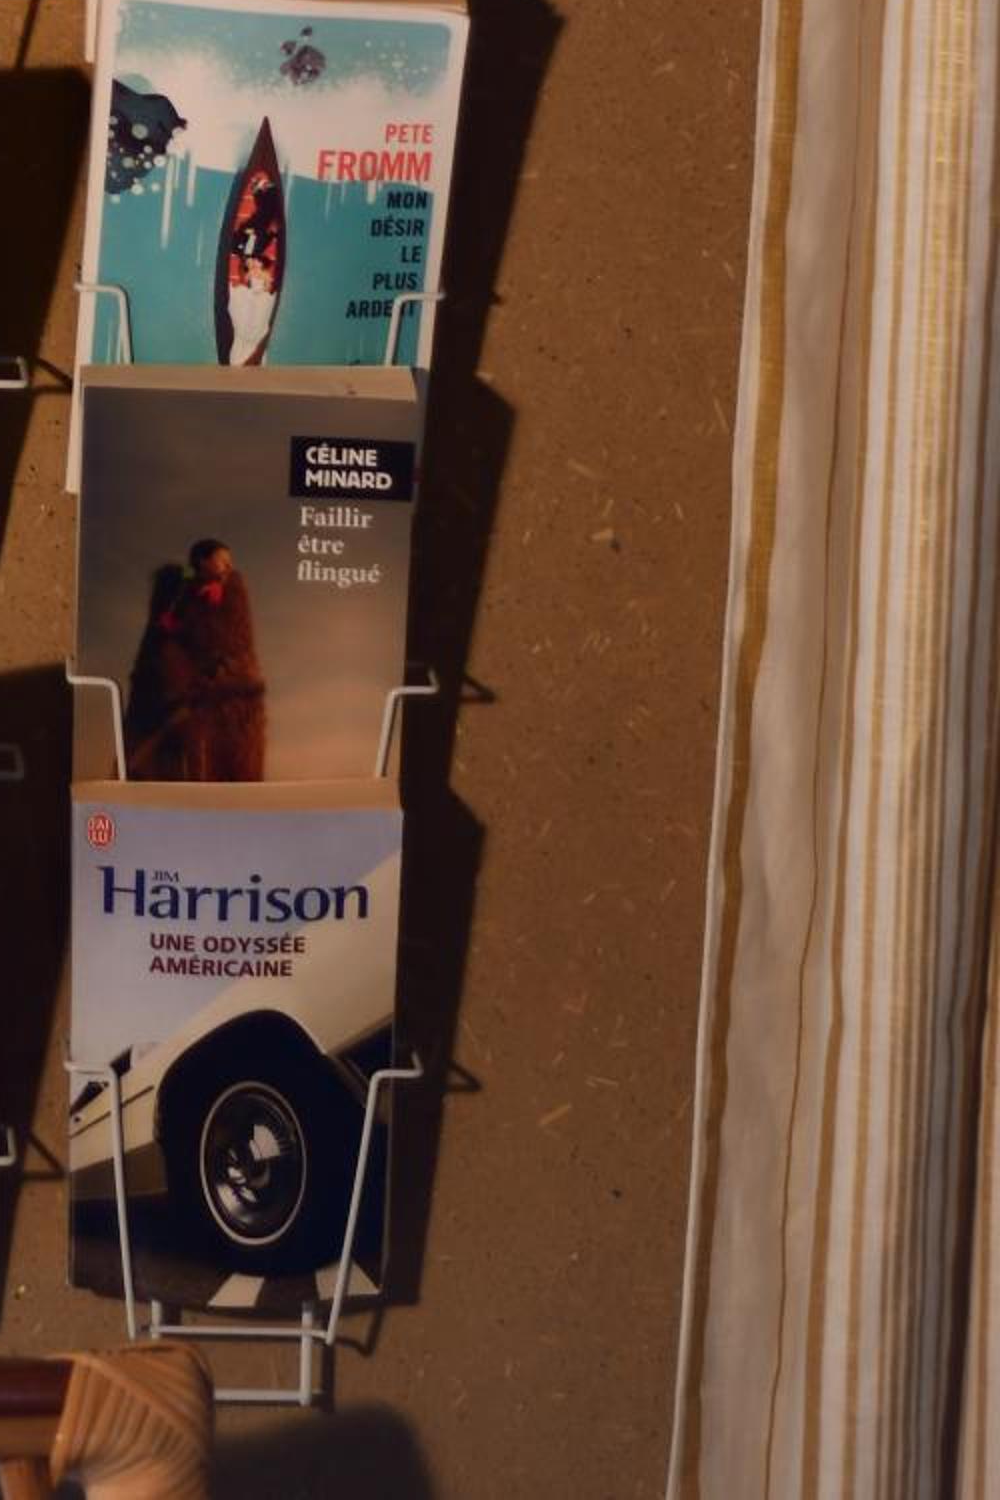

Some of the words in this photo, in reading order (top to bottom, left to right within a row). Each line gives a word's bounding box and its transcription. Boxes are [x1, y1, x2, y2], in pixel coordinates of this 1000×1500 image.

[385, 124, 433, 144] PETE
[317, 149, 433, 182] FROMM
[387, 191, 427, 210] MON
[371, 217, 424, 238] DÉSIR
[401, 246, 421, 263] LE
[372, 272, 417, 291] PLUS
[345, 299, 416, 319] ARDET
[305, 443, 377, 467] CÉLINE
[305, 469, 392, 490] MINARD
[300, 506, 373, 529] Faillir
[297, 534, 344, 554] être
[297, 559, 380, 589] flingué
[152, 871, 179, 882] JIM
[97, 865, 369, 924] Harrison
[150, 932, 195, 953] UNE
[203, 931, 305, 954] ODYSSÉE
[150, 953, 292, 977] AMÉRICAINE
